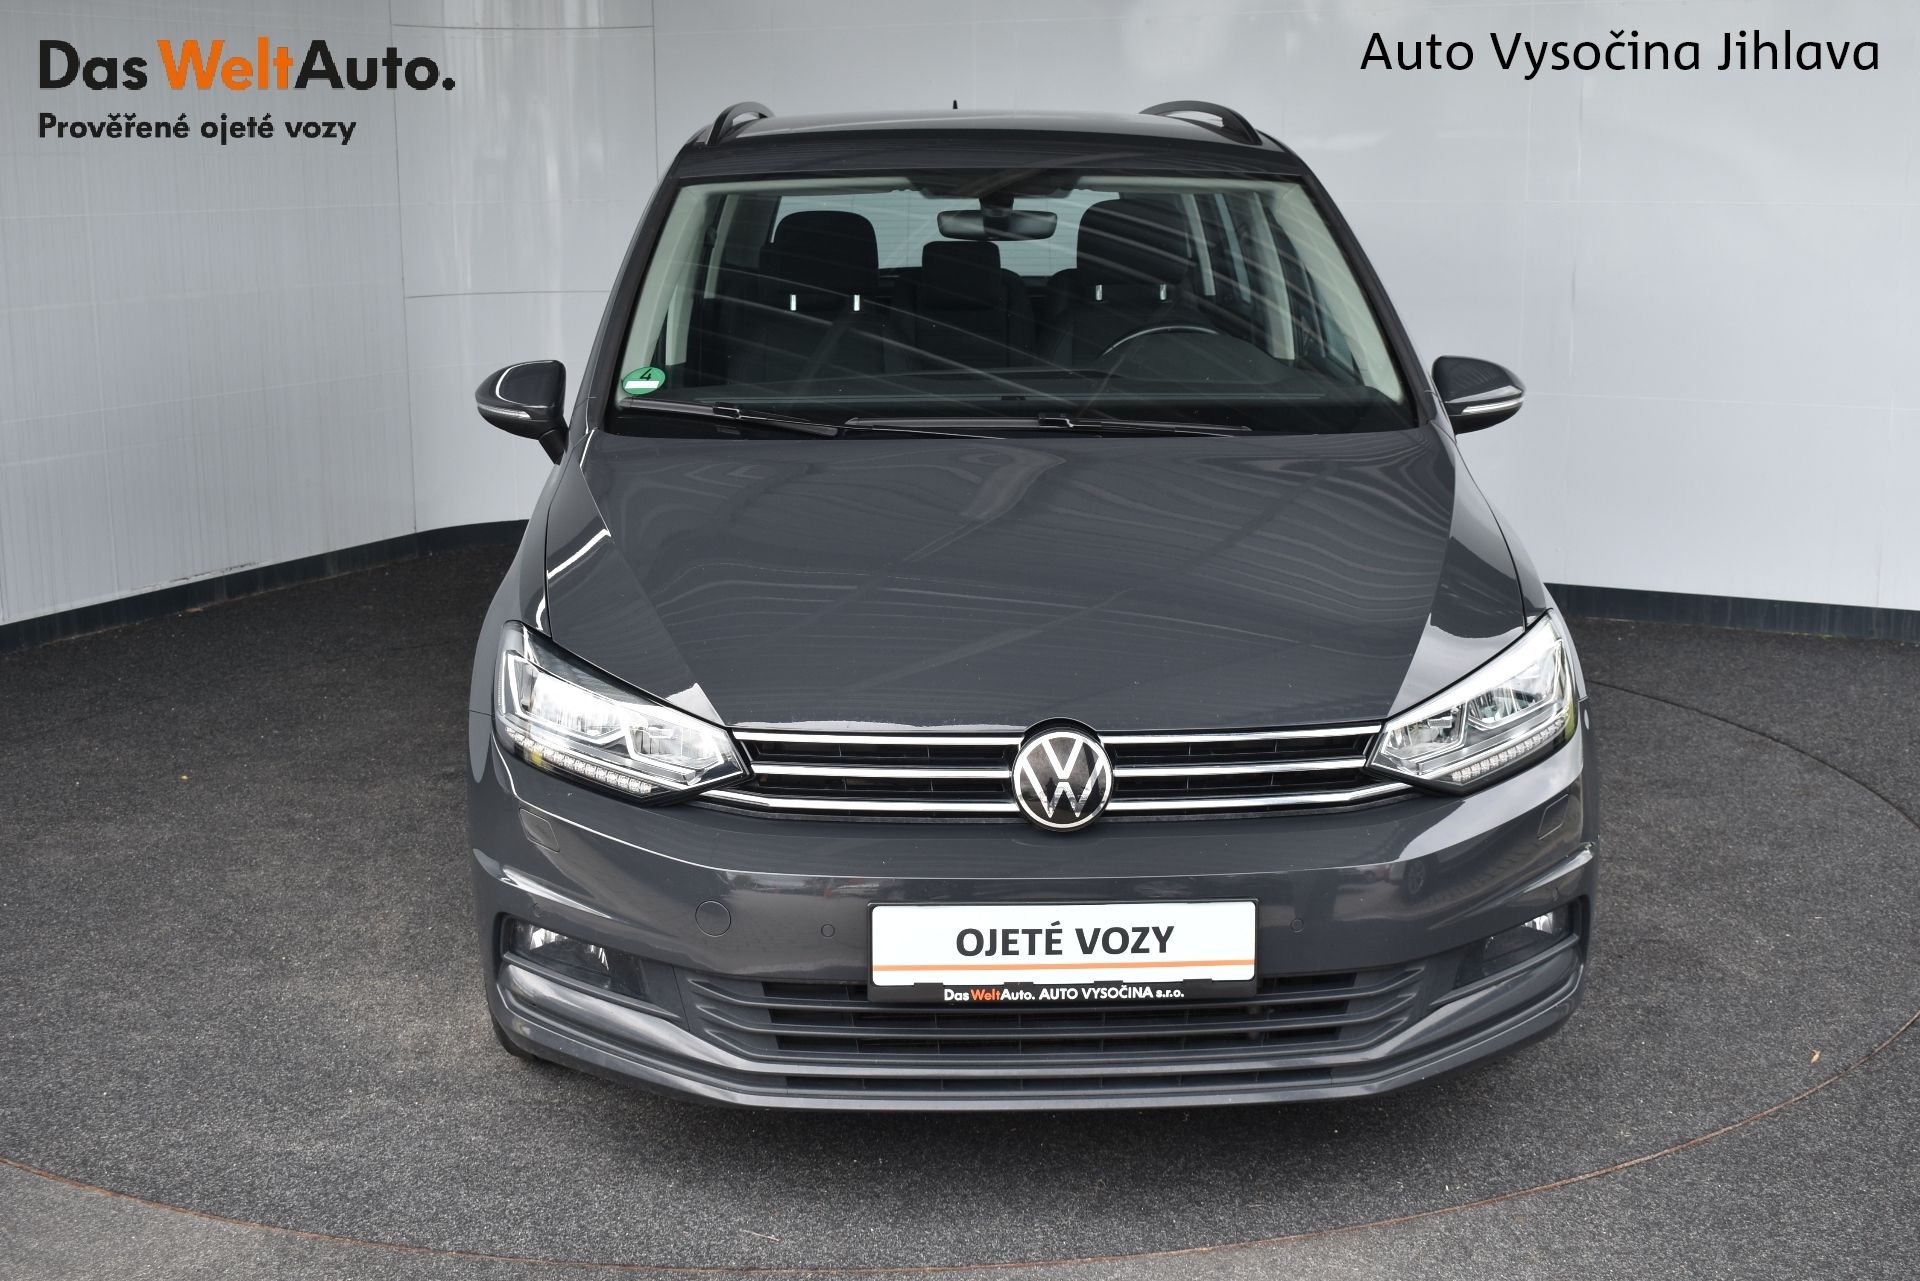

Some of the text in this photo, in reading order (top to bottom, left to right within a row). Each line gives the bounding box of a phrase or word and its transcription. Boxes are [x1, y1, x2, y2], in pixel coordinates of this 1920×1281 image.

[639, 368, 652, 381] 4
[956, 920, 1175, 957] OJETÉ VOZY
[943, 984, 1185, 1001] Das WeltAuto. AUTO VYSOČINA s.r.o.
